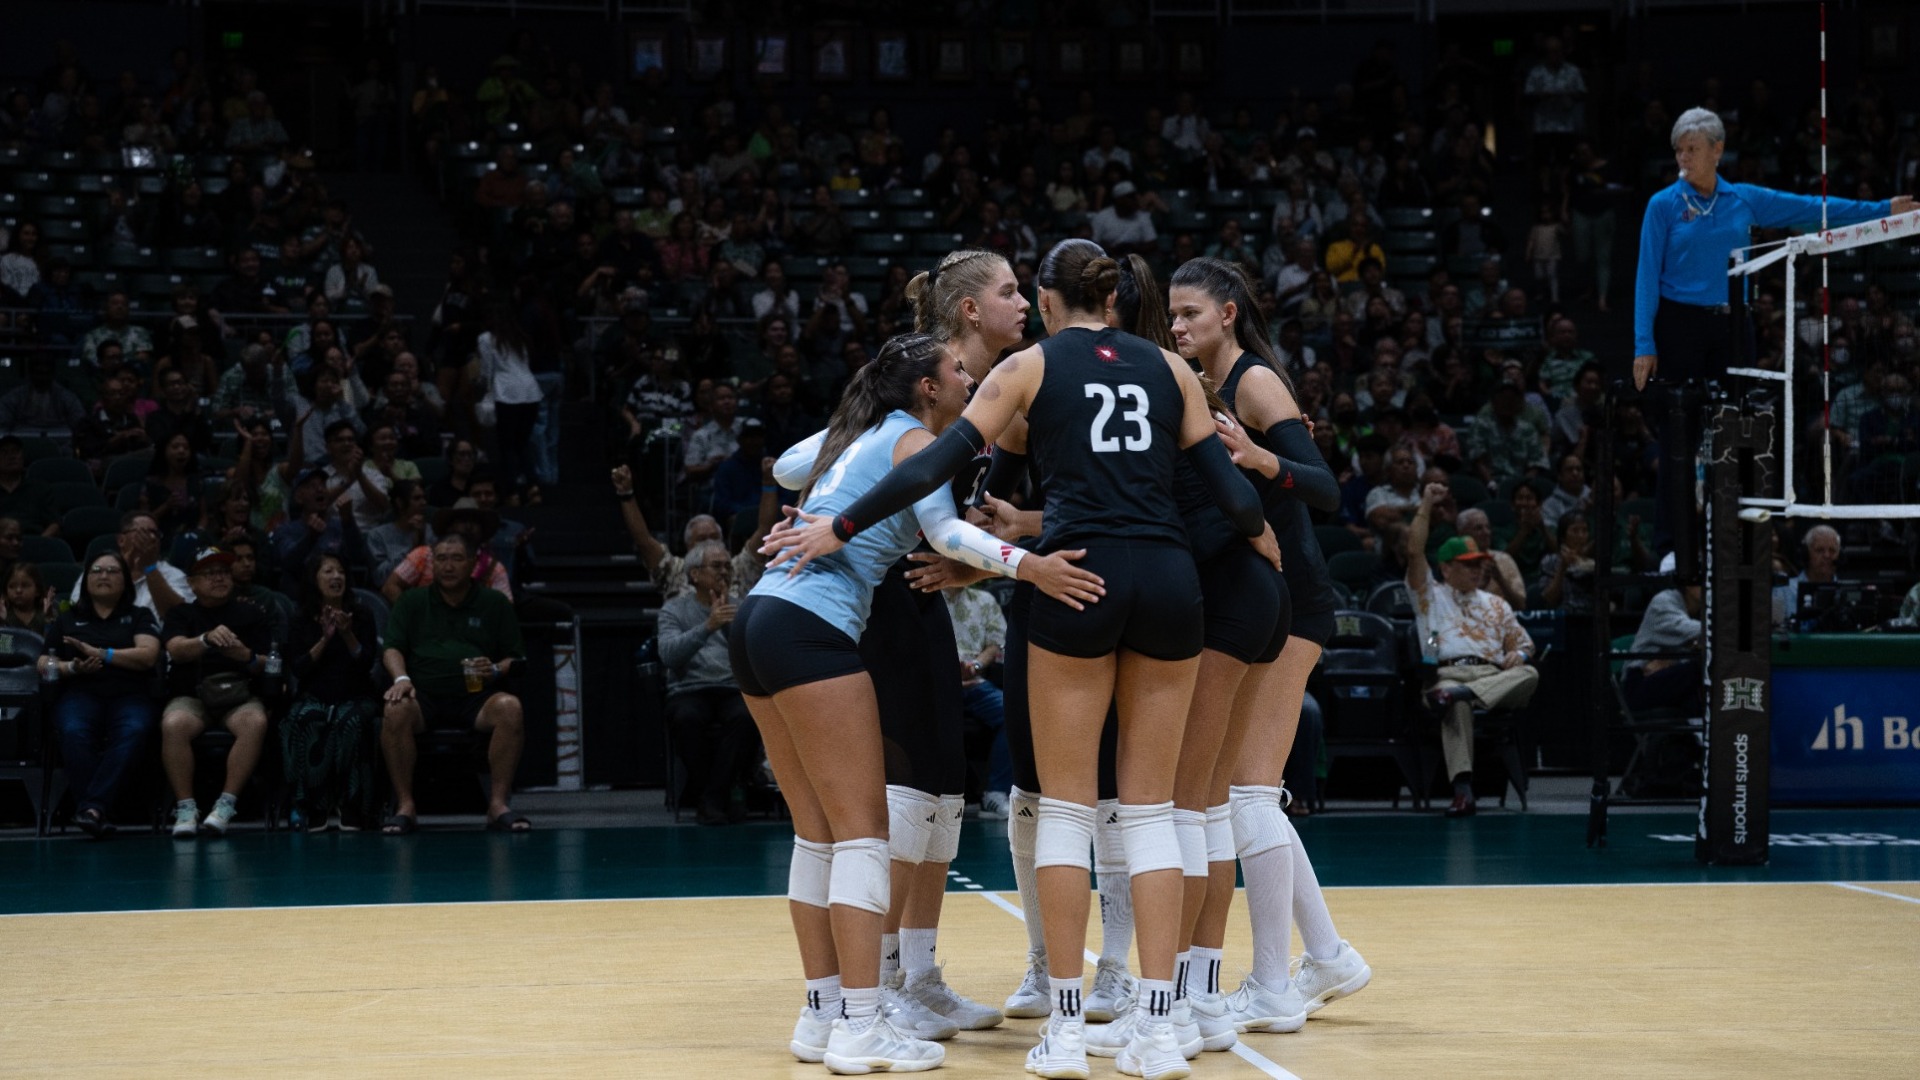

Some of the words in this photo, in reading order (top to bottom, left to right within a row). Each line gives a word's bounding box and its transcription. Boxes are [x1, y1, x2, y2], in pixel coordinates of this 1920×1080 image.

[1084, 383, 1152, 452] 23
[1733, 733, 1748, 782] sports
[1732, 784, 1748, 845] imports
